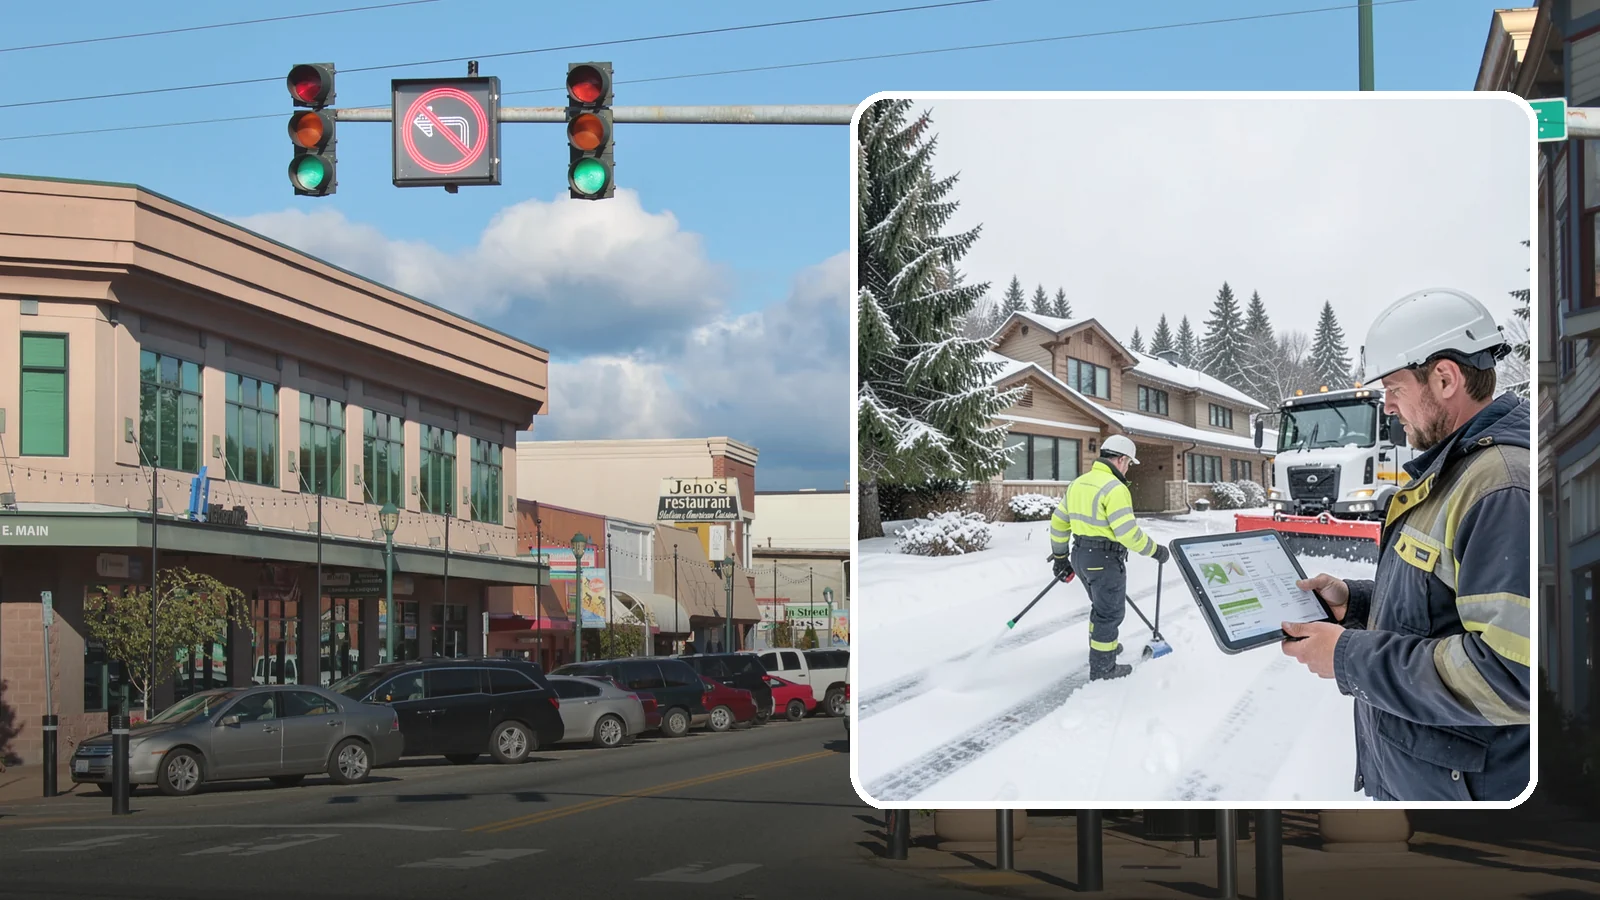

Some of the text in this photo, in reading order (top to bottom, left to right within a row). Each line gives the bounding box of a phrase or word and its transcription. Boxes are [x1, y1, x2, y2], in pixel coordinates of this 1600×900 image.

[669, 480, 727, 494] Jeno's
[665, 496, 731, 509] restaurant
[659, 510, 682, 519] Italian
[686, 509, 714, 519] American
[715, 509, 738, 519] Cuisine
[2, 525, 49, 536] E. MAIN
[797, 607, 828, 616] Street
